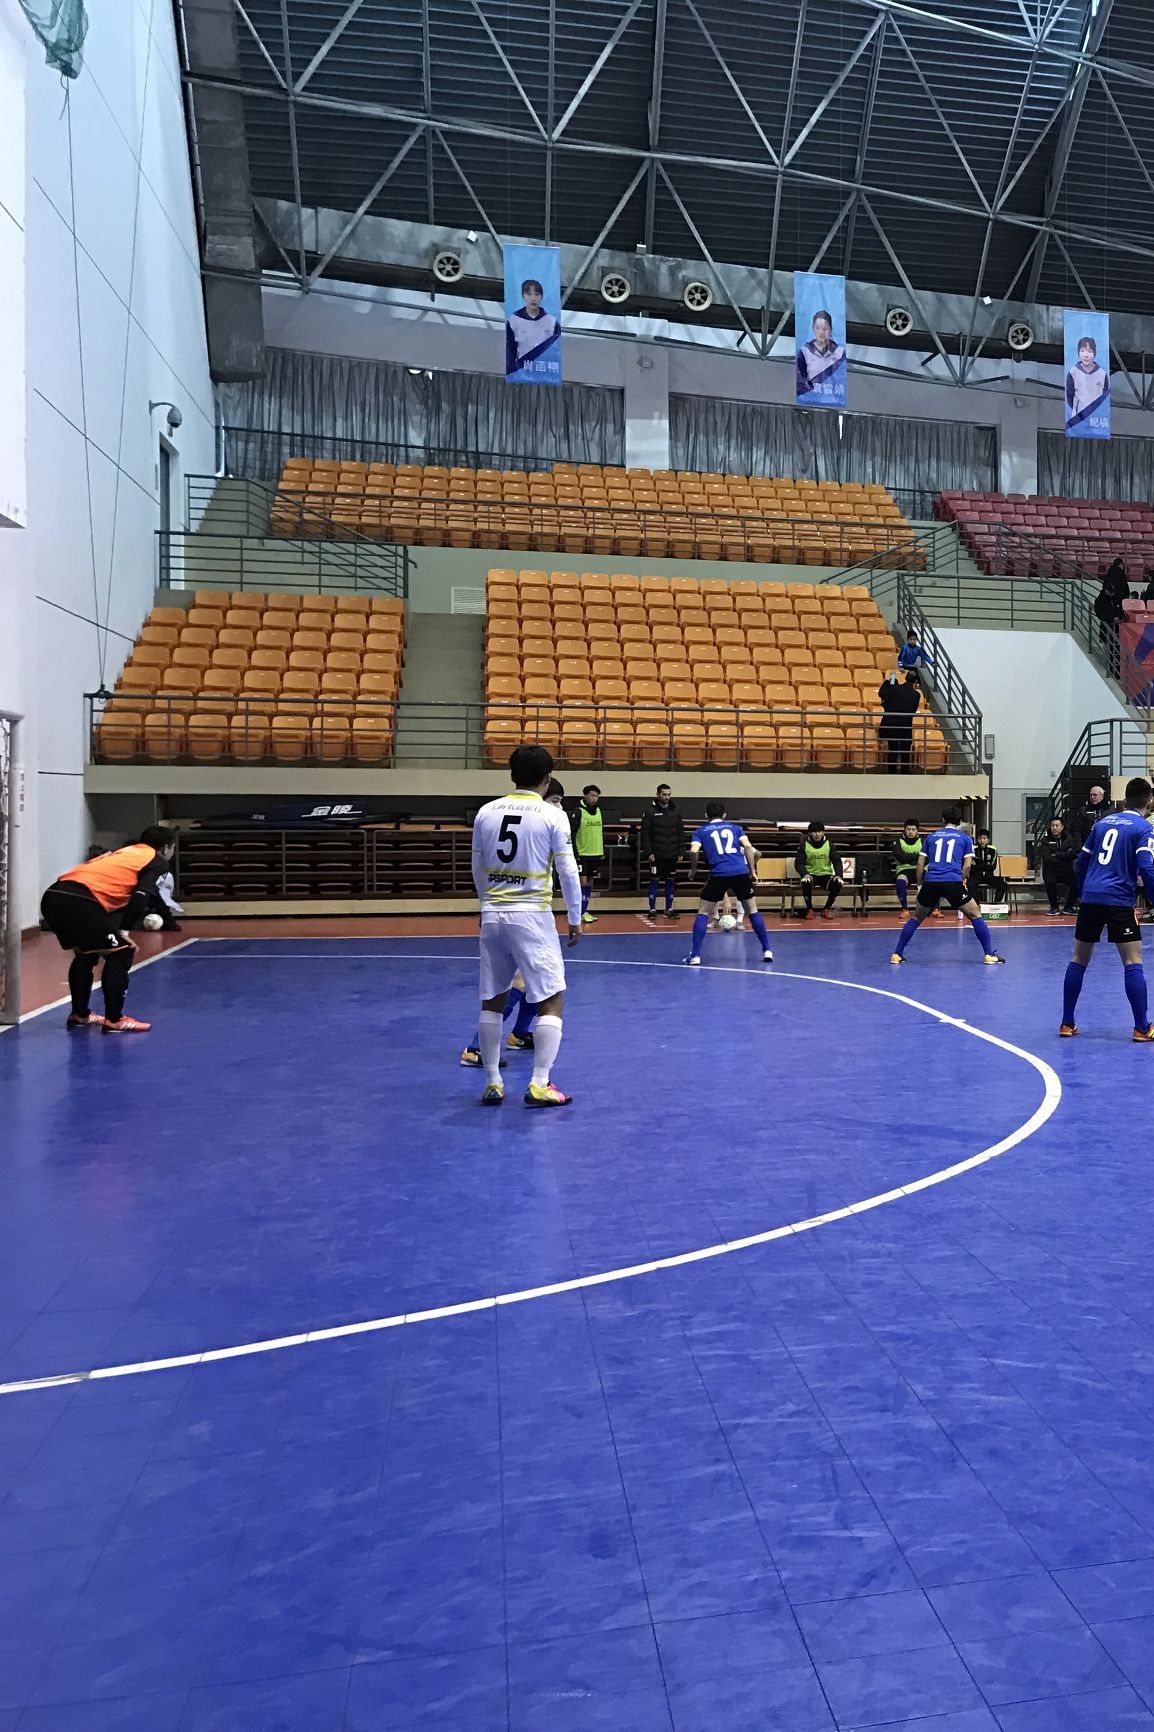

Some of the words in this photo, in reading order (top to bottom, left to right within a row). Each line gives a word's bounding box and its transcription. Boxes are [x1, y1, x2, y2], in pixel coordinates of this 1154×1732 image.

[496, 814, 522, 864] 5
[710, 828, 737, 855] 12
[934, 838, 956, 863] 11
[1097, 828, 1119, 865] 9
